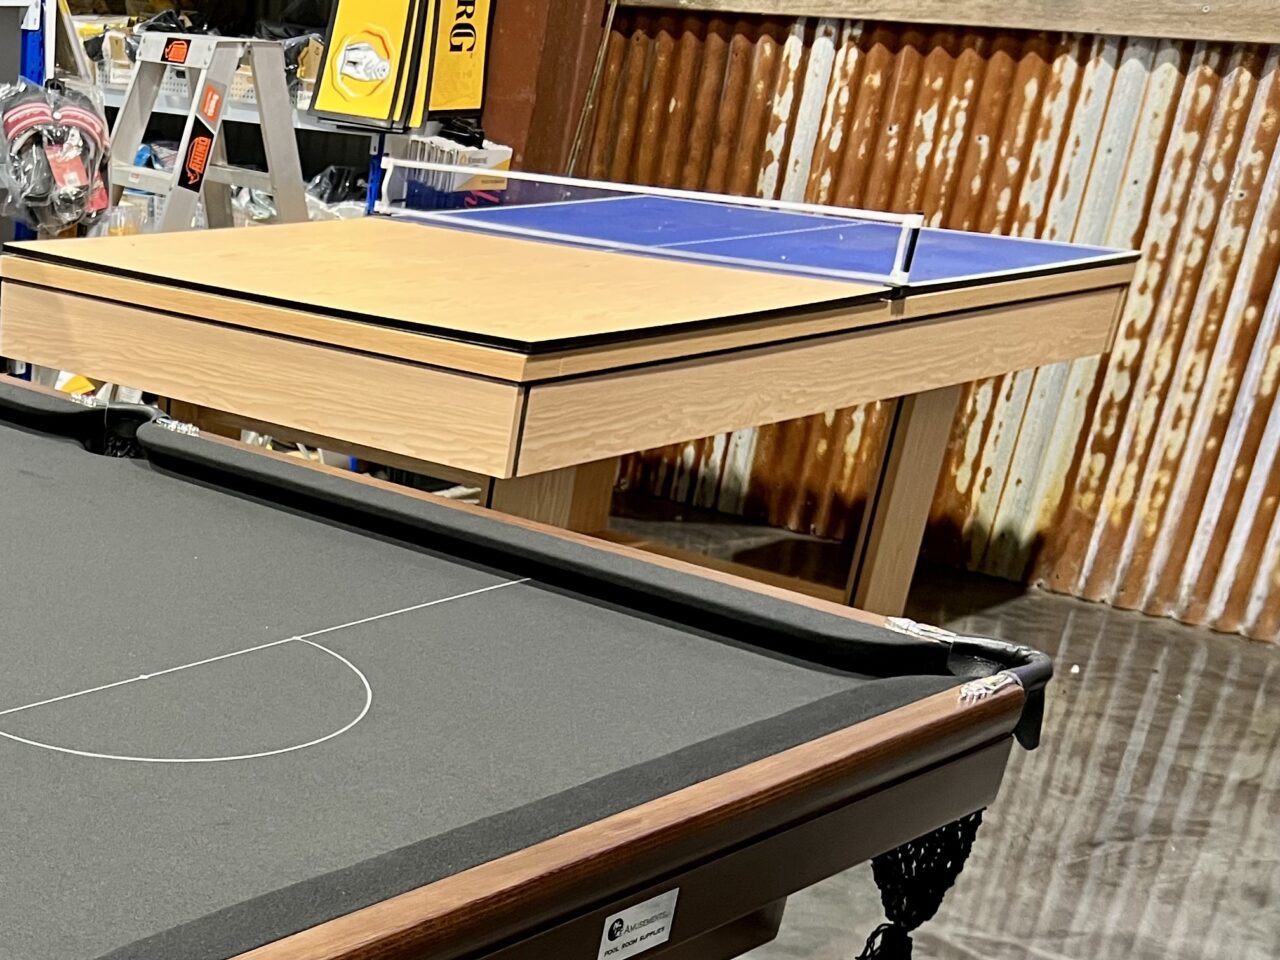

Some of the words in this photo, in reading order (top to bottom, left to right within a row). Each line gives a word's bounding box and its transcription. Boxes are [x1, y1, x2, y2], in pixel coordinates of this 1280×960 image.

[189, 137, 210, 172] RHINO
[604, 946, 619, 957] POOL
[621, 937, 638, 949] ROOM
[639, 926, 665, 941] SUPPLIES
